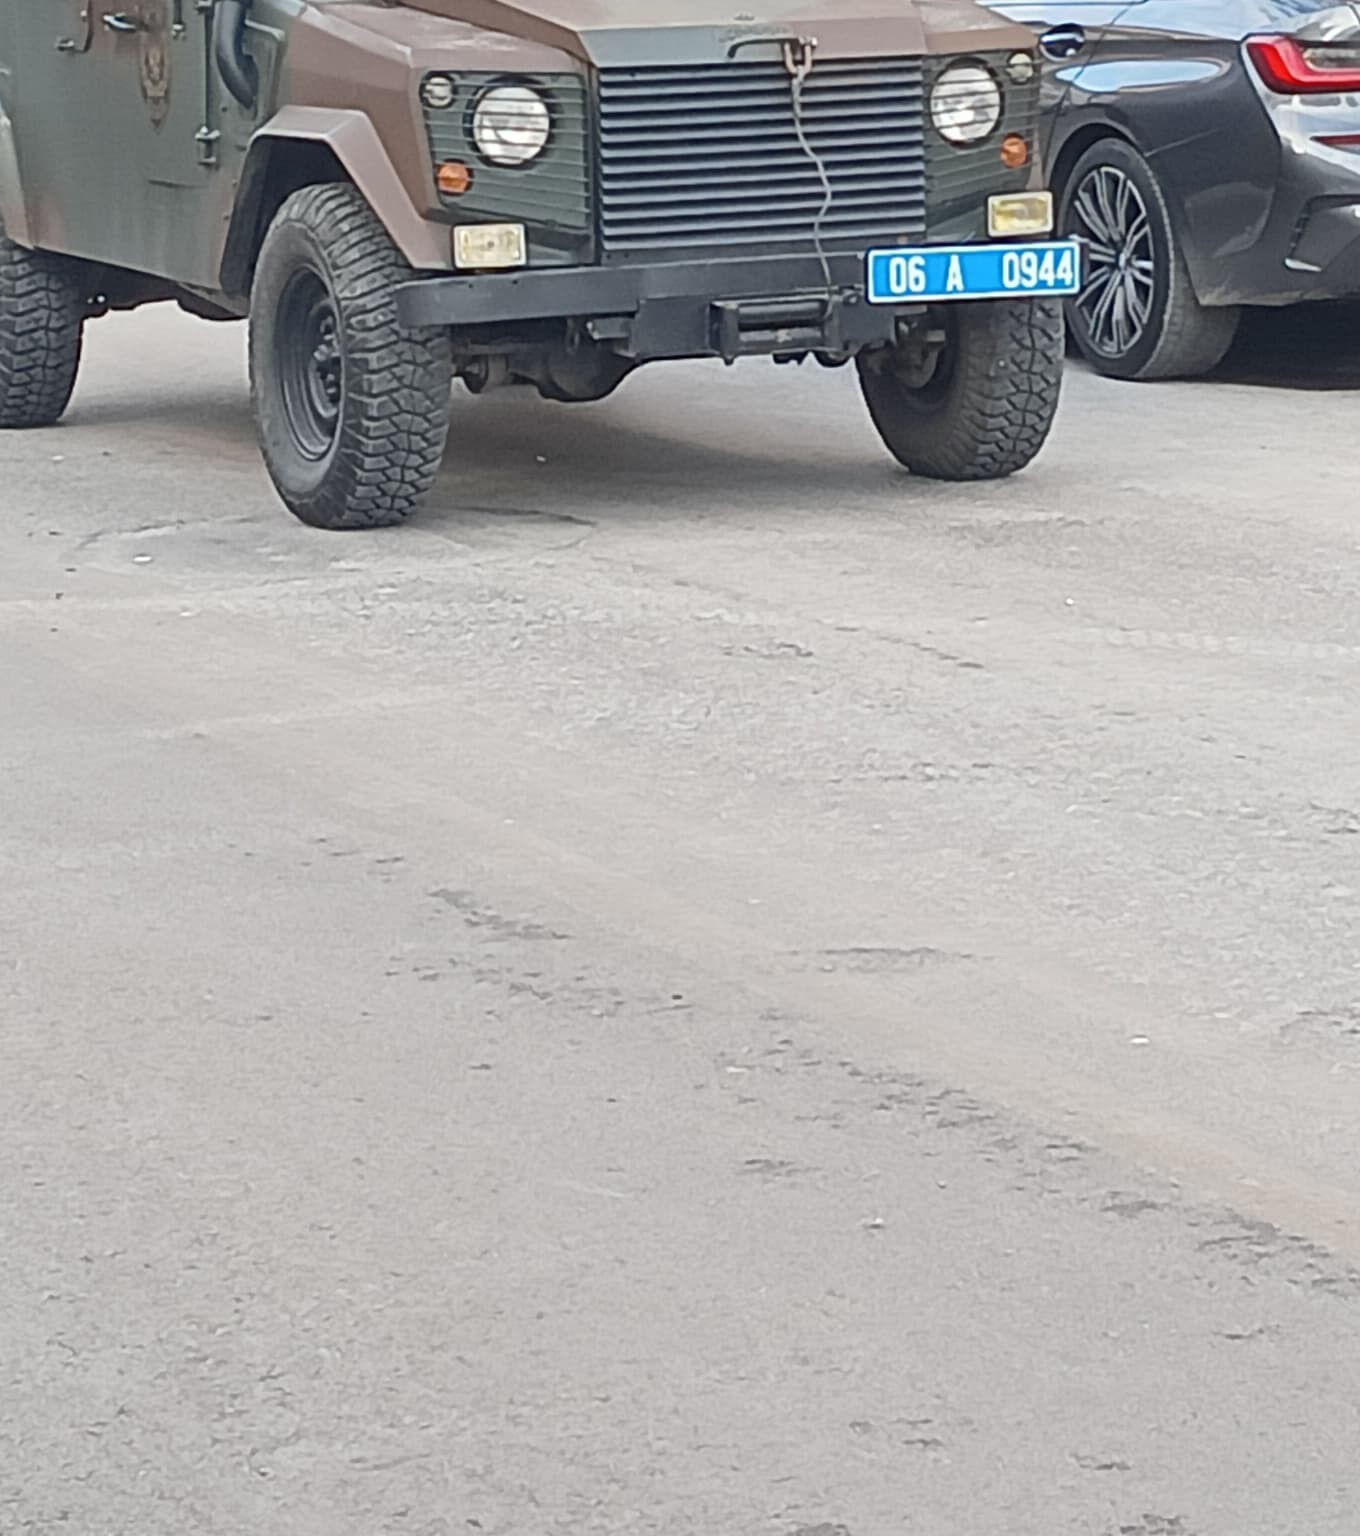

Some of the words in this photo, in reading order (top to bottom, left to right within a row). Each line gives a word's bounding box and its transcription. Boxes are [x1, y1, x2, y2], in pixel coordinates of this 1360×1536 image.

[889, 256, 927, 294] 06
[946, 254, 965, 292] A
[1001, 249, 1074, 289] 0944
